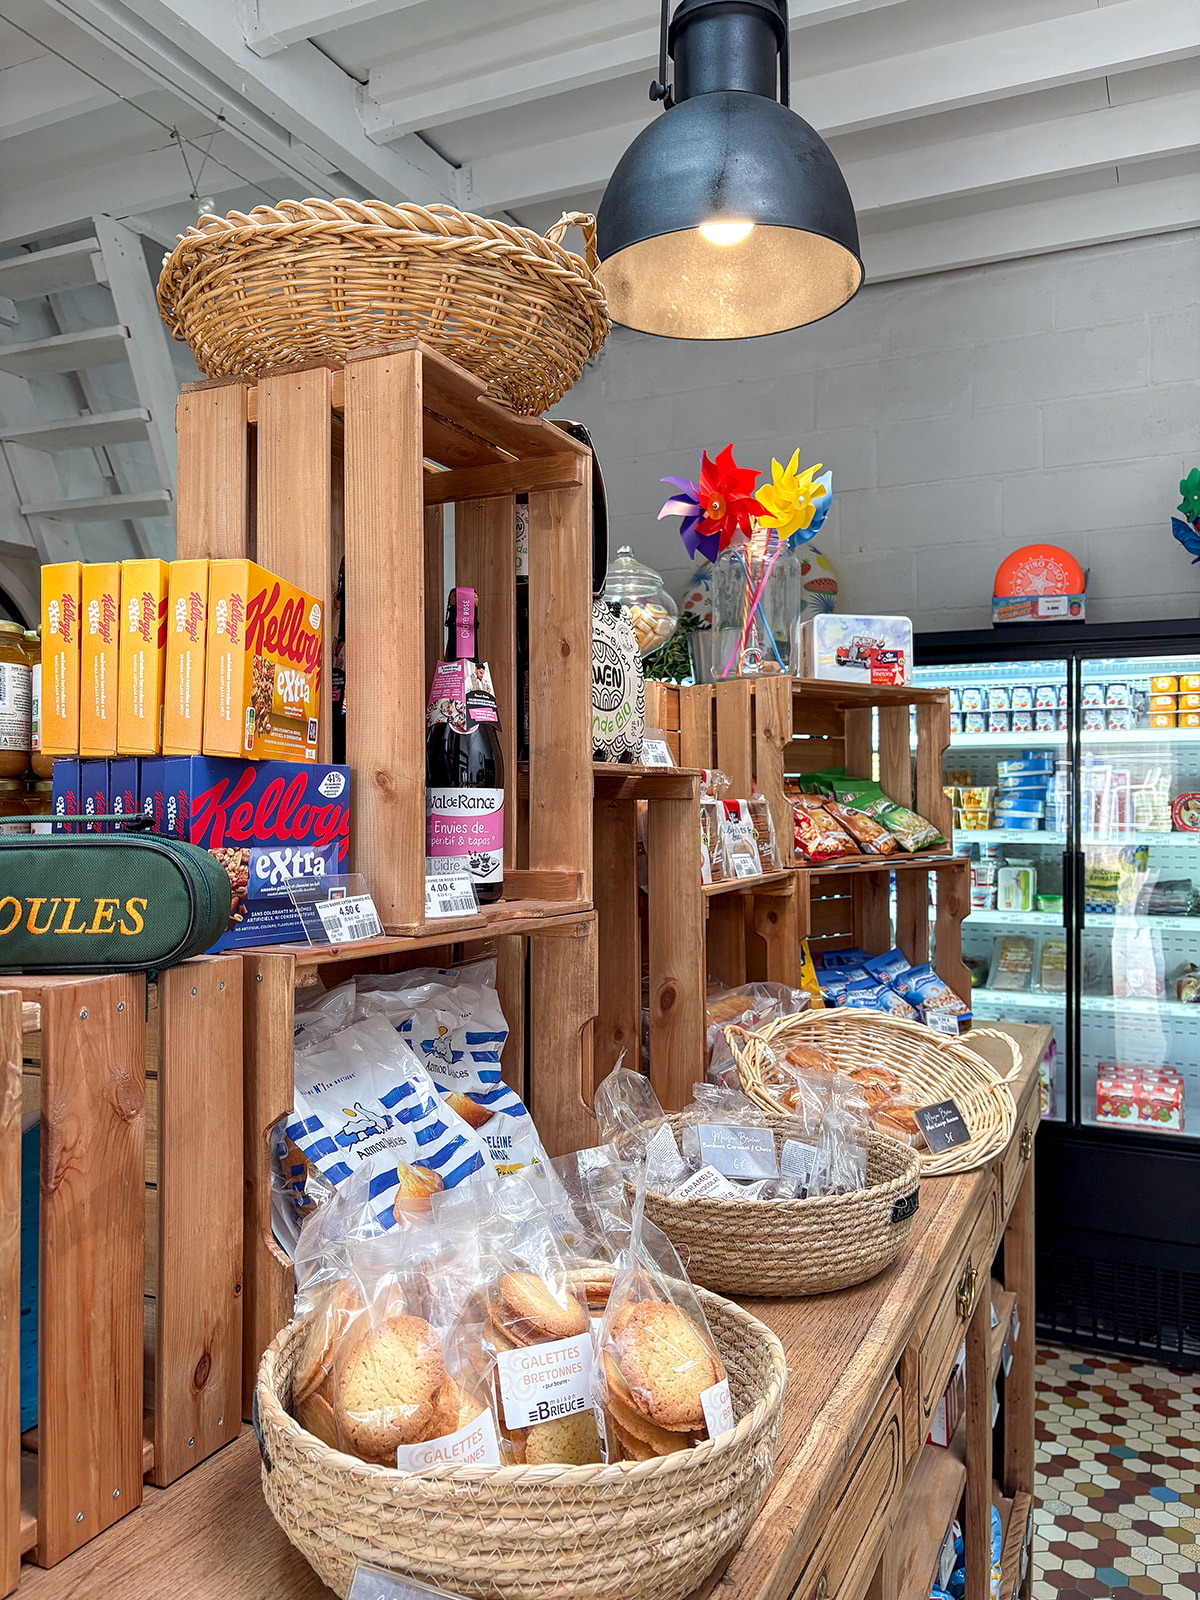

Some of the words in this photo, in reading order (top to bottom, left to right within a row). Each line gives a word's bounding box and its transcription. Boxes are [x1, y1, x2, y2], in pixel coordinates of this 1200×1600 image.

[58, 592, 77, 644] Kellogg's
[98, 593, 117, 645] Kellogg's
[138, 592, 156, 643] Kellogg's
[184, 592, 204, 643] Kellogg's
[225, 593, 245, 645] Kellogg's
[460, 617, 470, 639] Cidre
[276, 670, 310, 705] extra
[592, 664, 621, 689] WEN
[434, 821, 468, 834] Envies
[457, 837, 466, 846] &
[255, 847, 325, 885] extra
[433, 860, 460, 871] Cidre
[430, 883, 448, 892] 4.00
[449, 882, 456, 891] €
[339, 905, 354, 916] 4.50
[354, 904, 361, 913] €
[733, 1158, 747, 1170] 6€
[680, 1170, 714, 1198] CARAMELS
[521, 1345, 580, 1370] GALETTES
[523, 1362, 583, 1386] BRETONNES
[549, 1393, 577, 1405] maison
[423, 1427, 483, 1465] GALETTES
